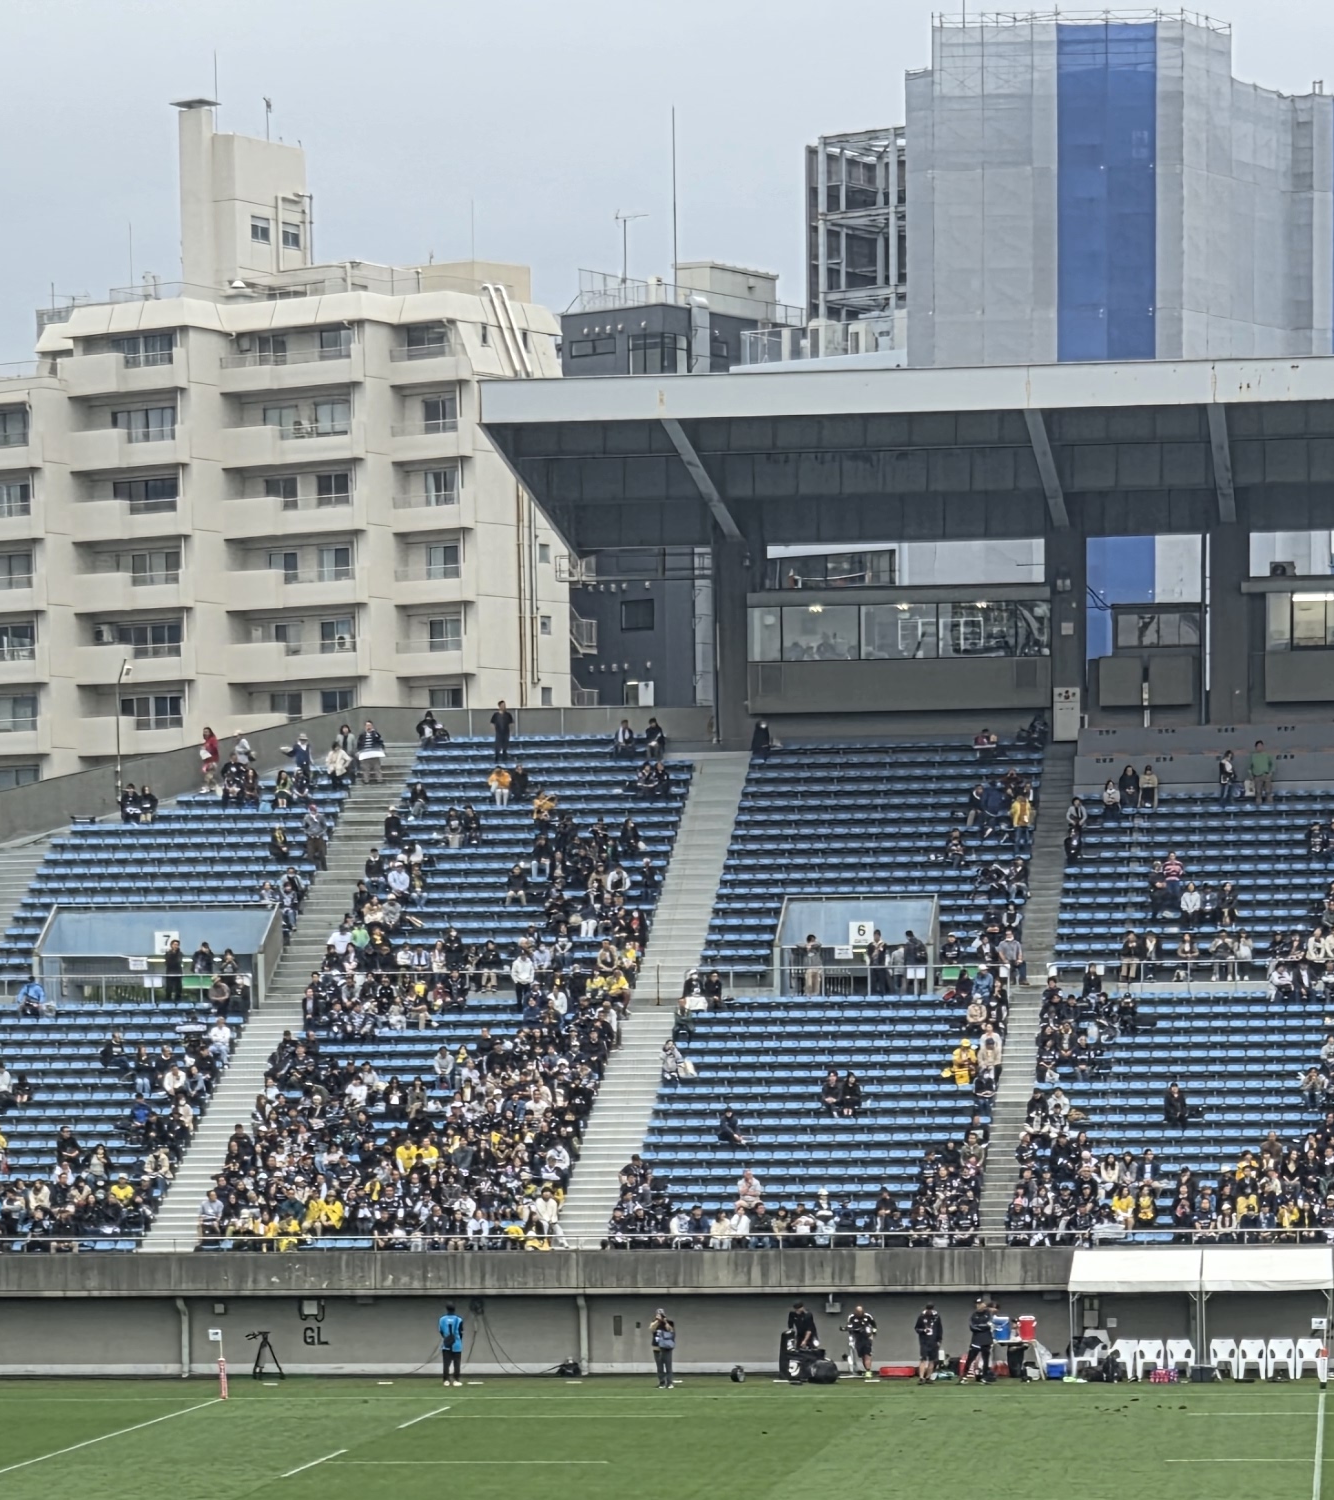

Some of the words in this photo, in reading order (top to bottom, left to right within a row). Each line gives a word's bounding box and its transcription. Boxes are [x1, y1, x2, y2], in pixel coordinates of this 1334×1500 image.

[857, 924, 866, 937] 6
[162, 934, 171, 947] 7
[303, 1326, 330, 1346] GL
